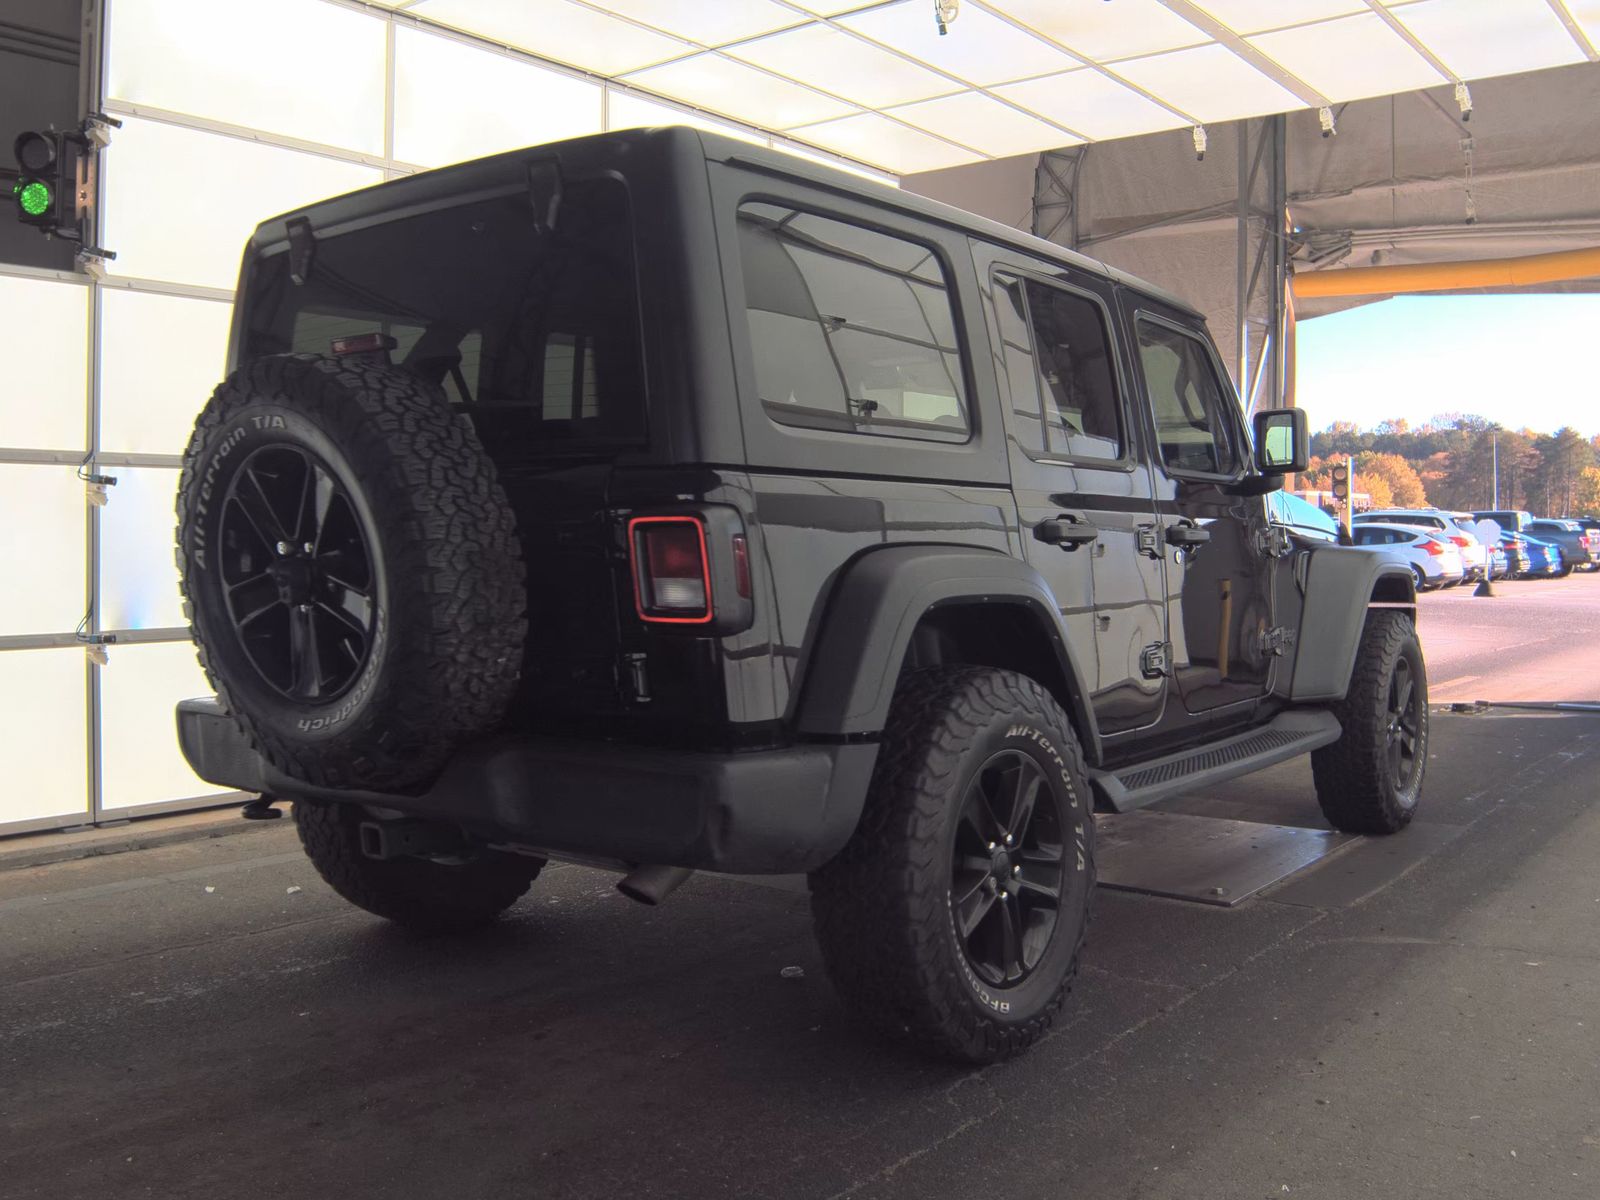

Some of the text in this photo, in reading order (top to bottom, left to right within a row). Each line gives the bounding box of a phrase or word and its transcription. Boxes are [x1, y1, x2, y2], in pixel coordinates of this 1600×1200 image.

[194, 415, 286, 570] All-Terrain T/A
[298, 608, 385, 733] Goodrich
[1005, 726, 1086, 871] All-Terrain T/A
[947, 889, 1010, 1014] BFGoo
